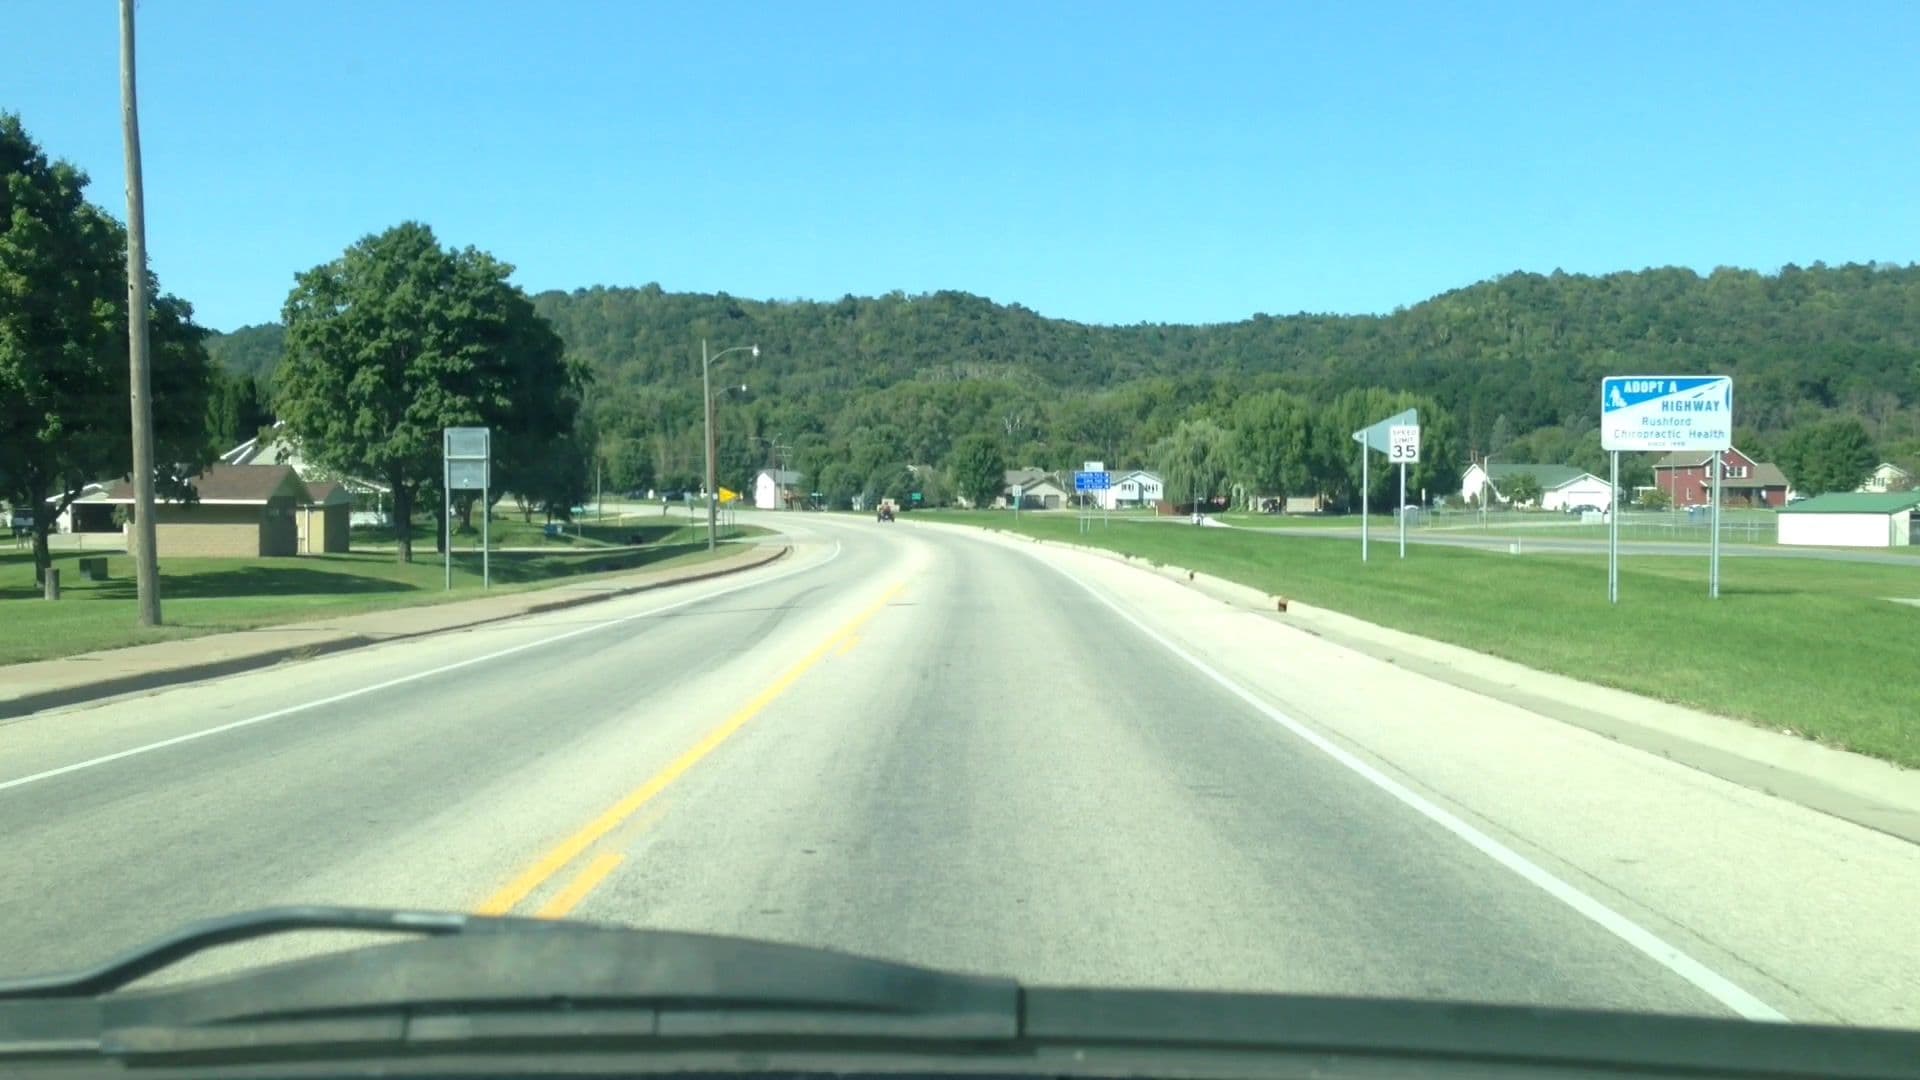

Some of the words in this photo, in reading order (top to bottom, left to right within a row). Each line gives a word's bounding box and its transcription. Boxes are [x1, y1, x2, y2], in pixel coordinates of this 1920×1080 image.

[1623, 380, 1664, 393] ADOPT
[1668, 380, 1677, 393] A
[1661, 400, 1720, 412] HIGHWAY
[1642, 416, 1692, 426] Rushford
[1614, 429, 1681, 440] Chiropractic
[1689, 429, 1725, 439] Health
[1393, 444, 1416, 458] 35
